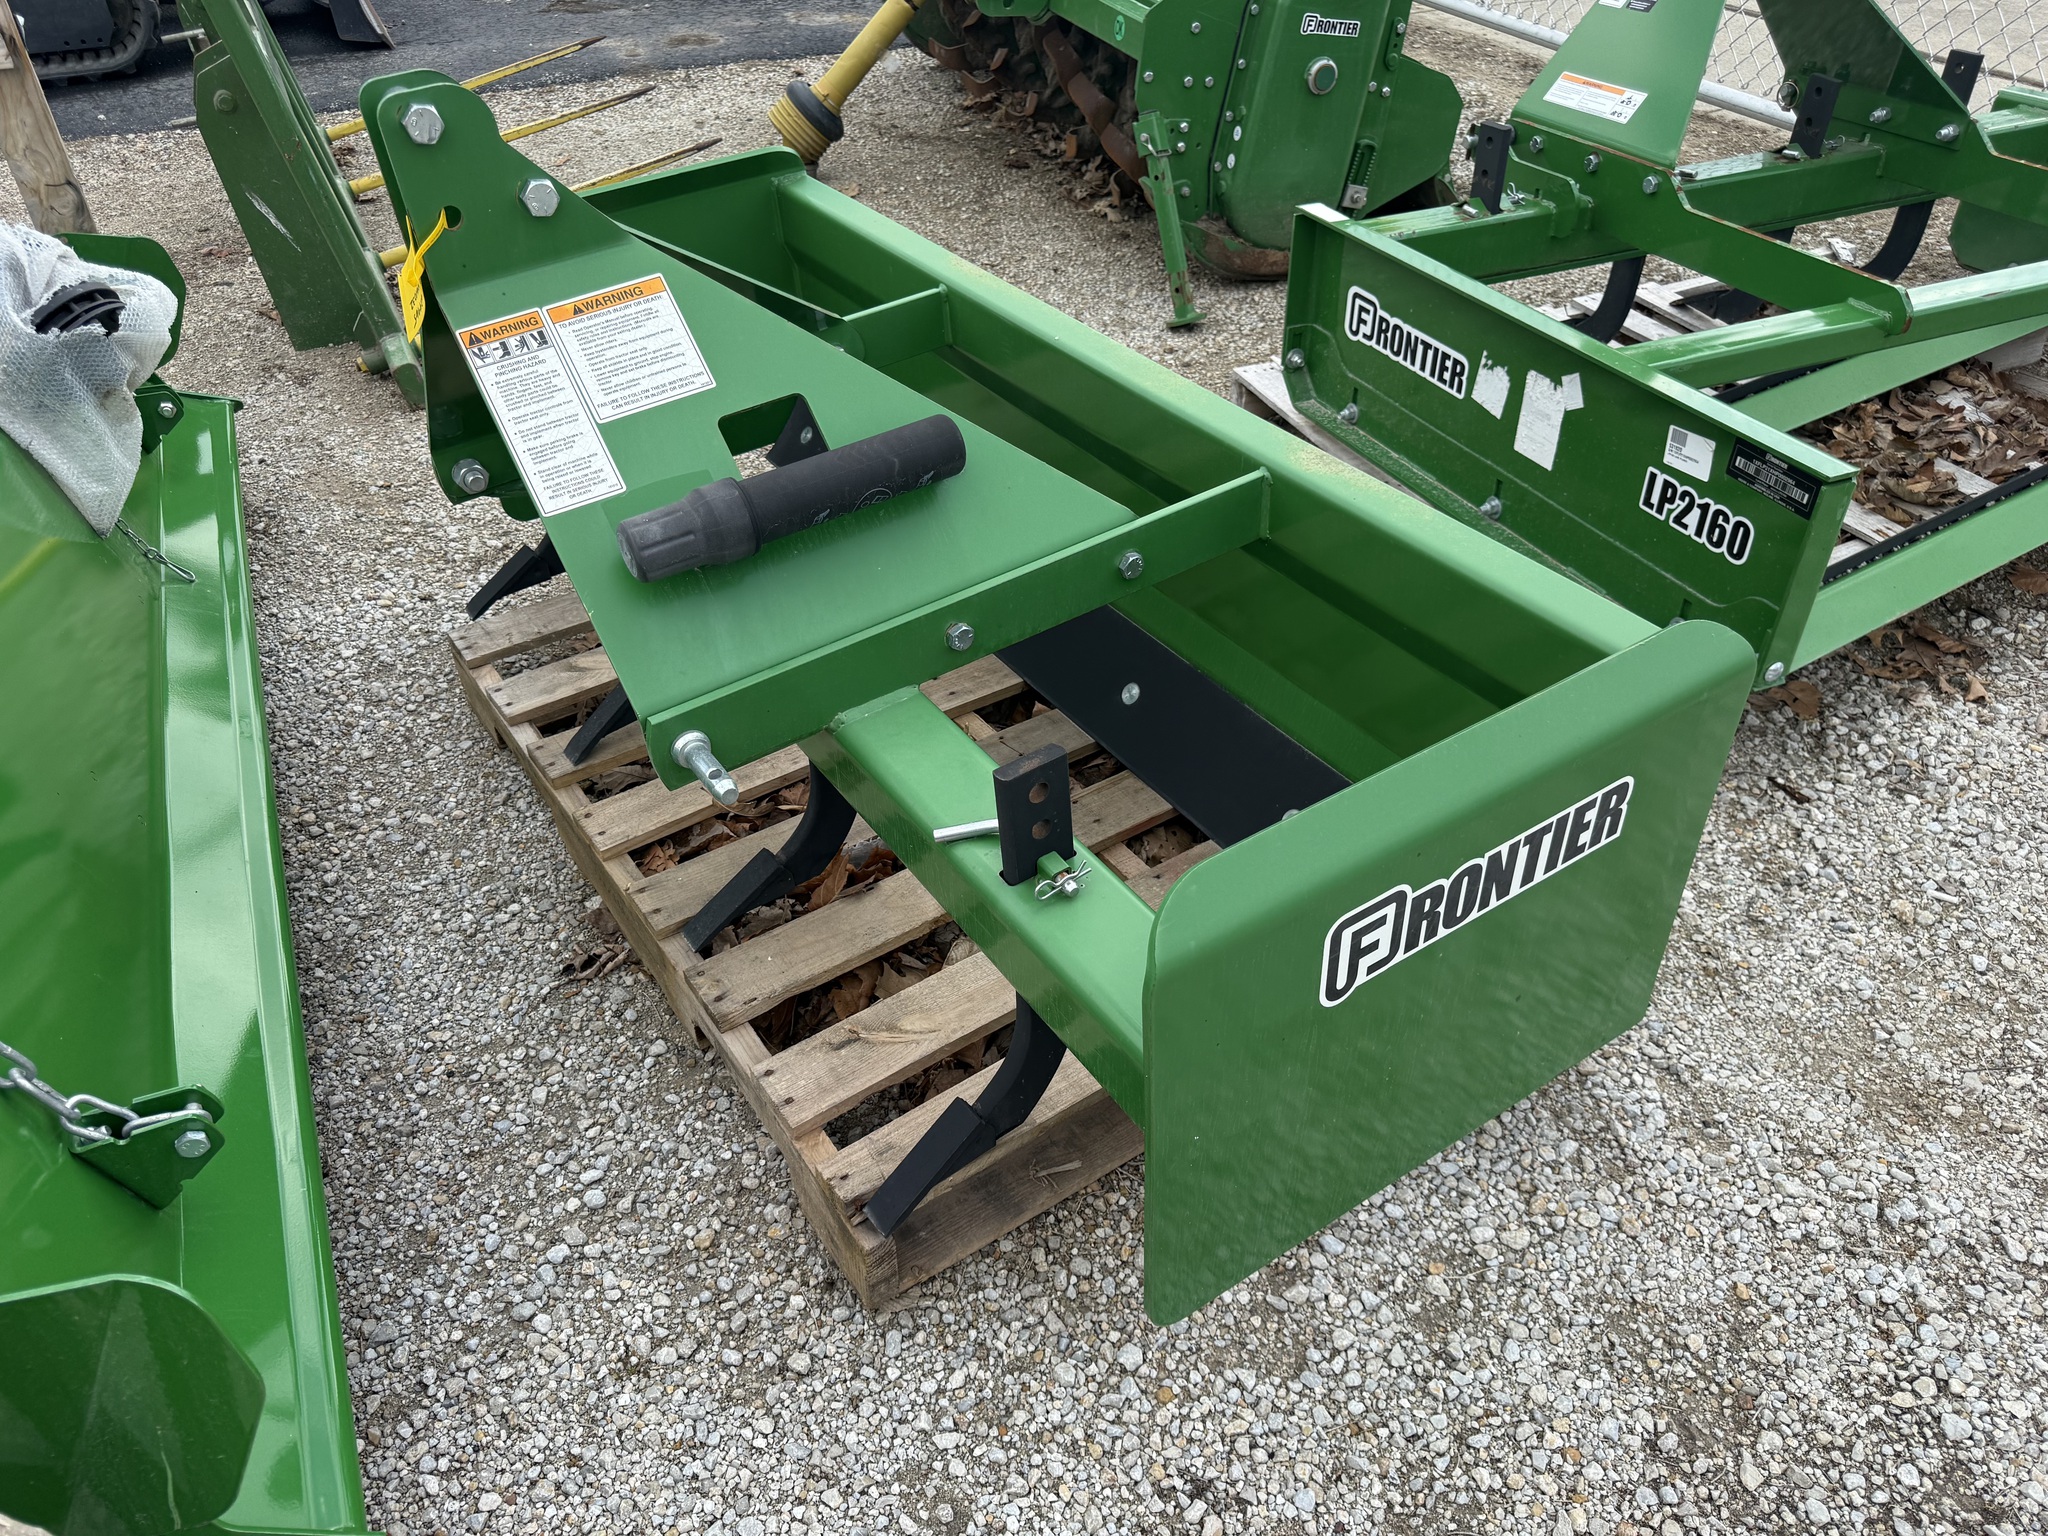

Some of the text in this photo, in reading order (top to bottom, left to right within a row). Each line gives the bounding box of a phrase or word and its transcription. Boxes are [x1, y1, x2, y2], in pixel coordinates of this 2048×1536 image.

[1302, 14, 1358, 36] FRONTIER
[582, 287, 643, 310] WARNING
[568, 318, 585, 326] AVOID
[586, 310, 612, 321] SERIOUS
[612, 304, 632, 313] INJURY
[643, 295, 662, 304] DEATH:
[480, 317, 538, 339] WARNING
[1348, 292, 1466, 394] FRONTIER
[495, 359, 546, 377] PINCHING HAZARD
[497, 359, 526, 370] CRUSHING
[597, 398, 619, 408] FAILURE
[628, 389, 650, 398] FOLLOW
[668, 371, 704, 386] INSTRUCTIONS
[624, 397, 643, 406] RESULT
[650, 389, 668, 397] INJURY
[678, 381, 695, 389] DEATH.
[543, 482, 562, 490] FAILURE
[570, 473, 589, 482] FOLLOW
[549, 491, 566, 500] RESULT
[572, 483, 592, 492] SERIOUS
[552, 480, 584, 493] INSTRUCTIONS
[1641, 471, 1751, 561] LP2160
[1325, 782, 1630, 1003] FRONTIER
